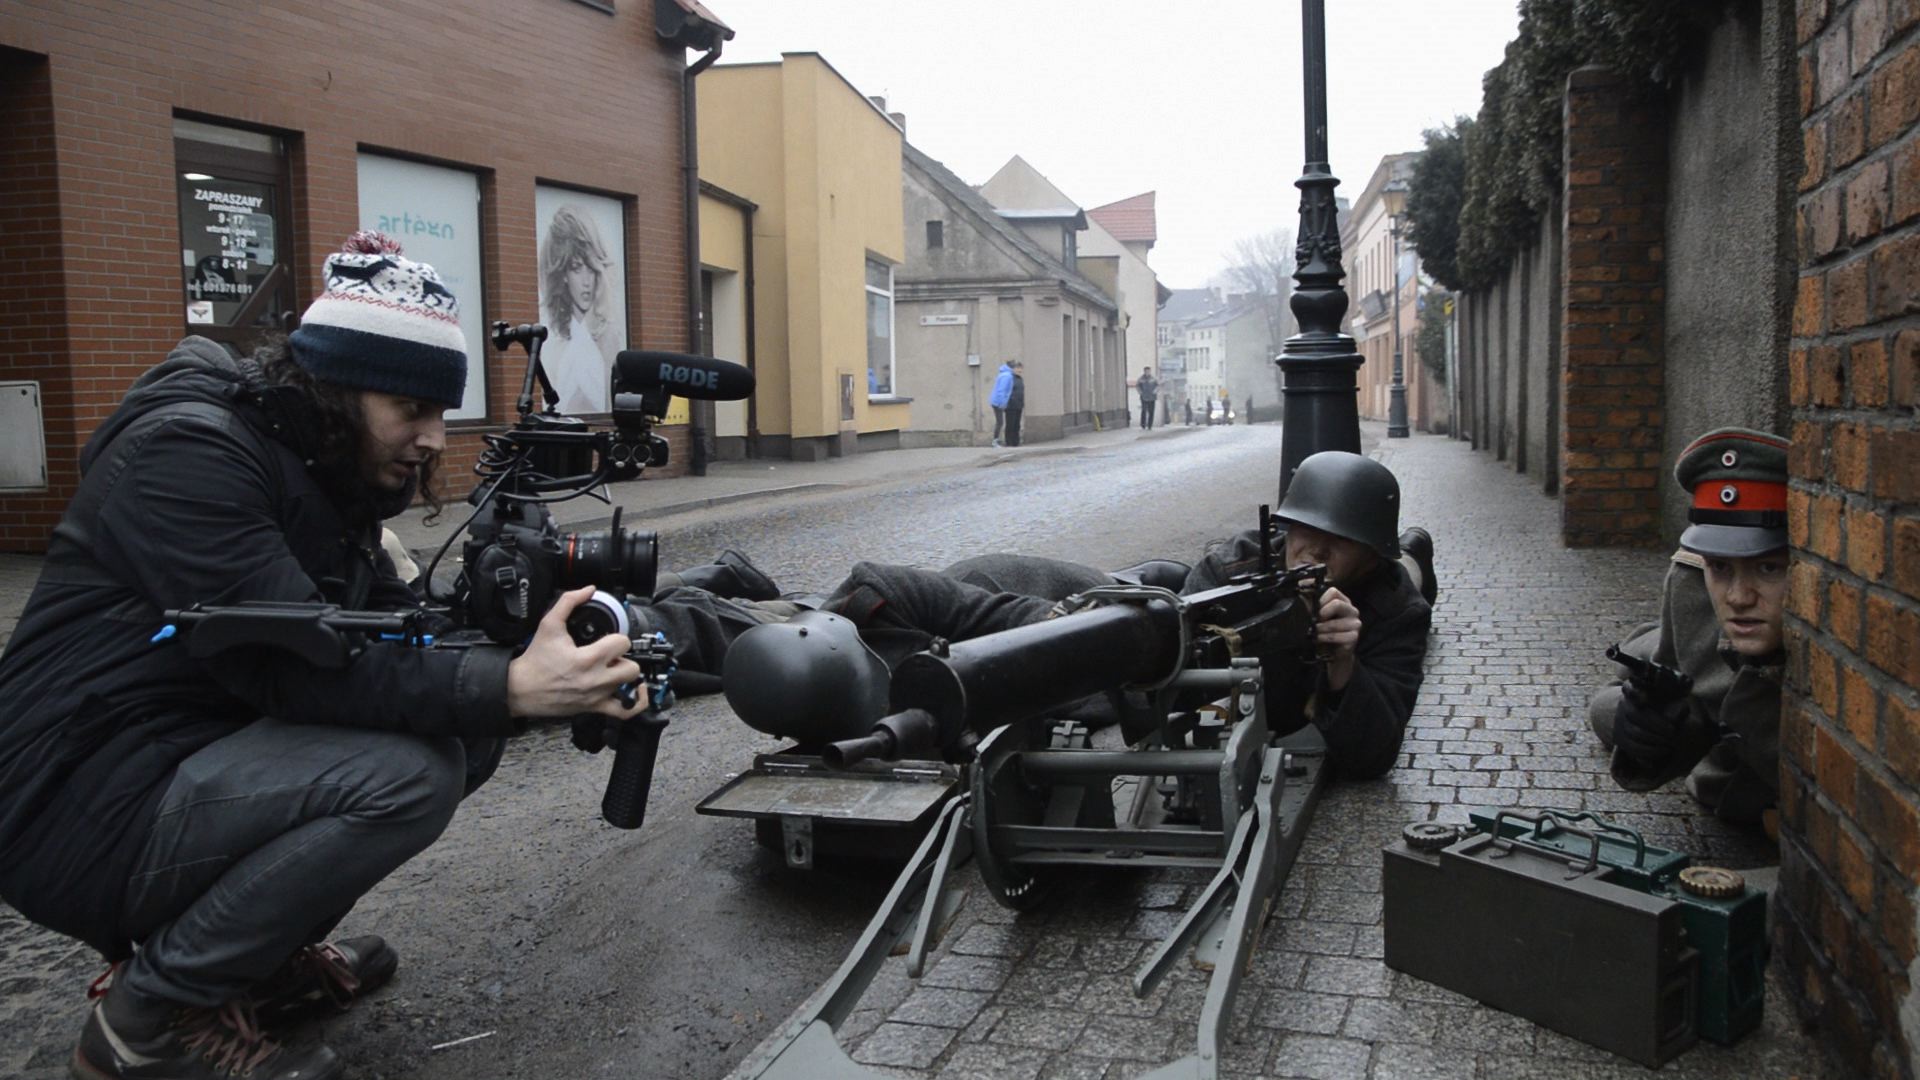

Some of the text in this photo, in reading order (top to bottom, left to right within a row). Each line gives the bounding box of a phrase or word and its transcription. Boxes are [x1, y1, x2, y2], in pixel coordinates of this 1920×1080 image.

[194, 188, 263, 208] ZAPRASZAMY
[218, 212, 226, 224] 9
[233, 214, 244, 225] 17
[221, 235, 228, 247] 9
[222, 258, 229, 270] 8
[236, 259, 248, 270] 14
[659, 362, 719, 390] RØDE
